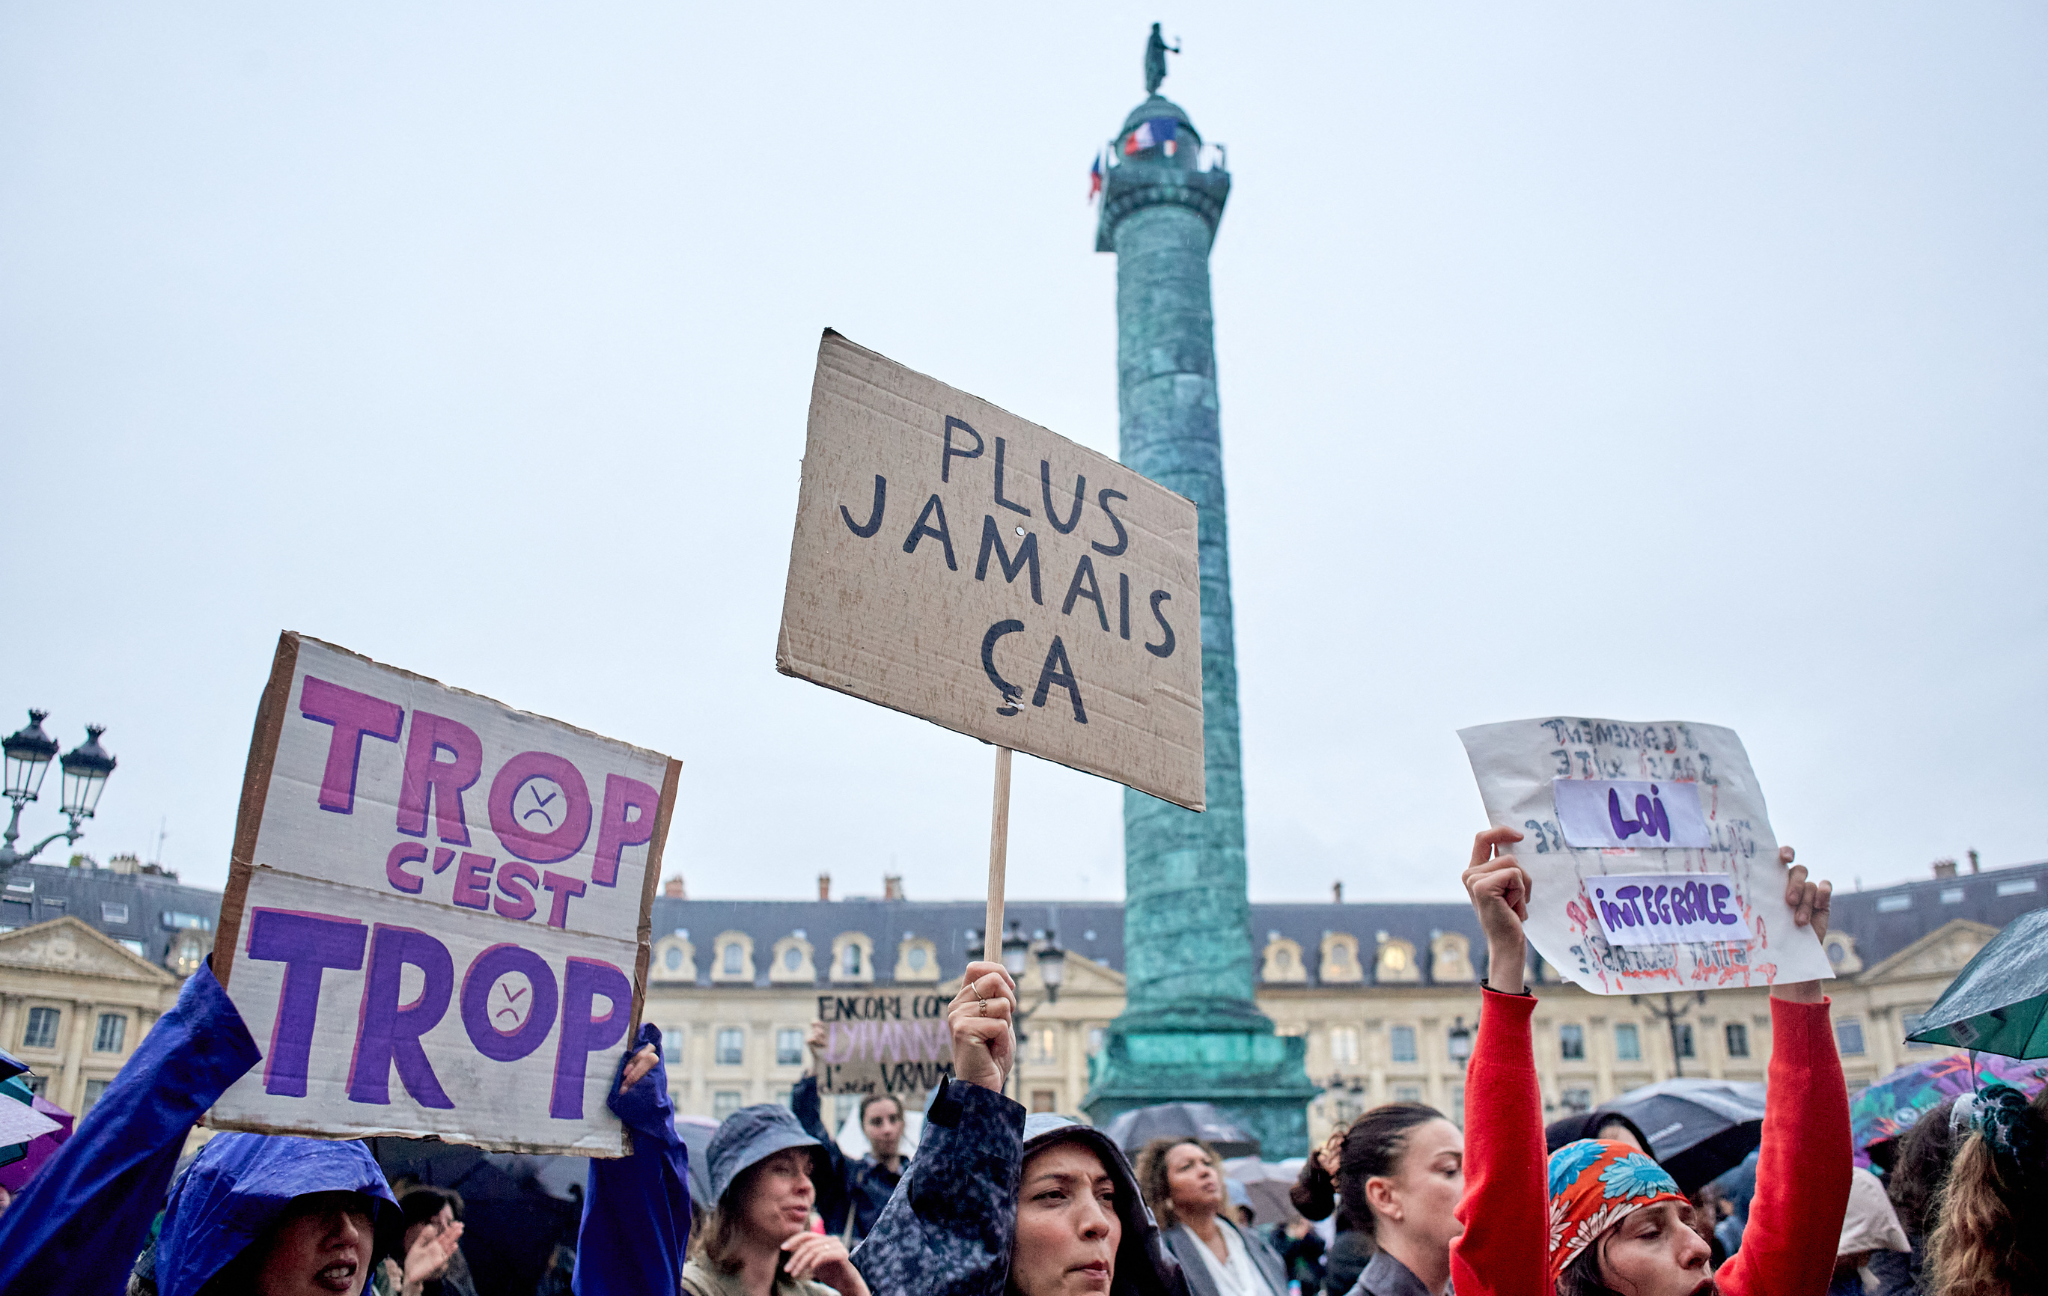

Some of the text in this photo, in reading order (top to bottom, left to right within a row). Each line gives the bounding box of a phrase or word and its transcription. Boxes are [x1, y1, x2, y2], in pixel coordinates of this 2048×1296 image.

[941, 415, 1128, 557] PLUS
[840, 474, 1177, 659] JAMAIS
[981, 619, 1088, 725] ÇA
[299, 675, 661, 887] TROP
[1608, 784, 1671, 843] LOi
[386, 842, 587, 928] C'EST
[245, 906, 631, 1120] TROP
[913, 995, 957, 1019] COM
[880, 1062, 957, 1093] VRAIM
